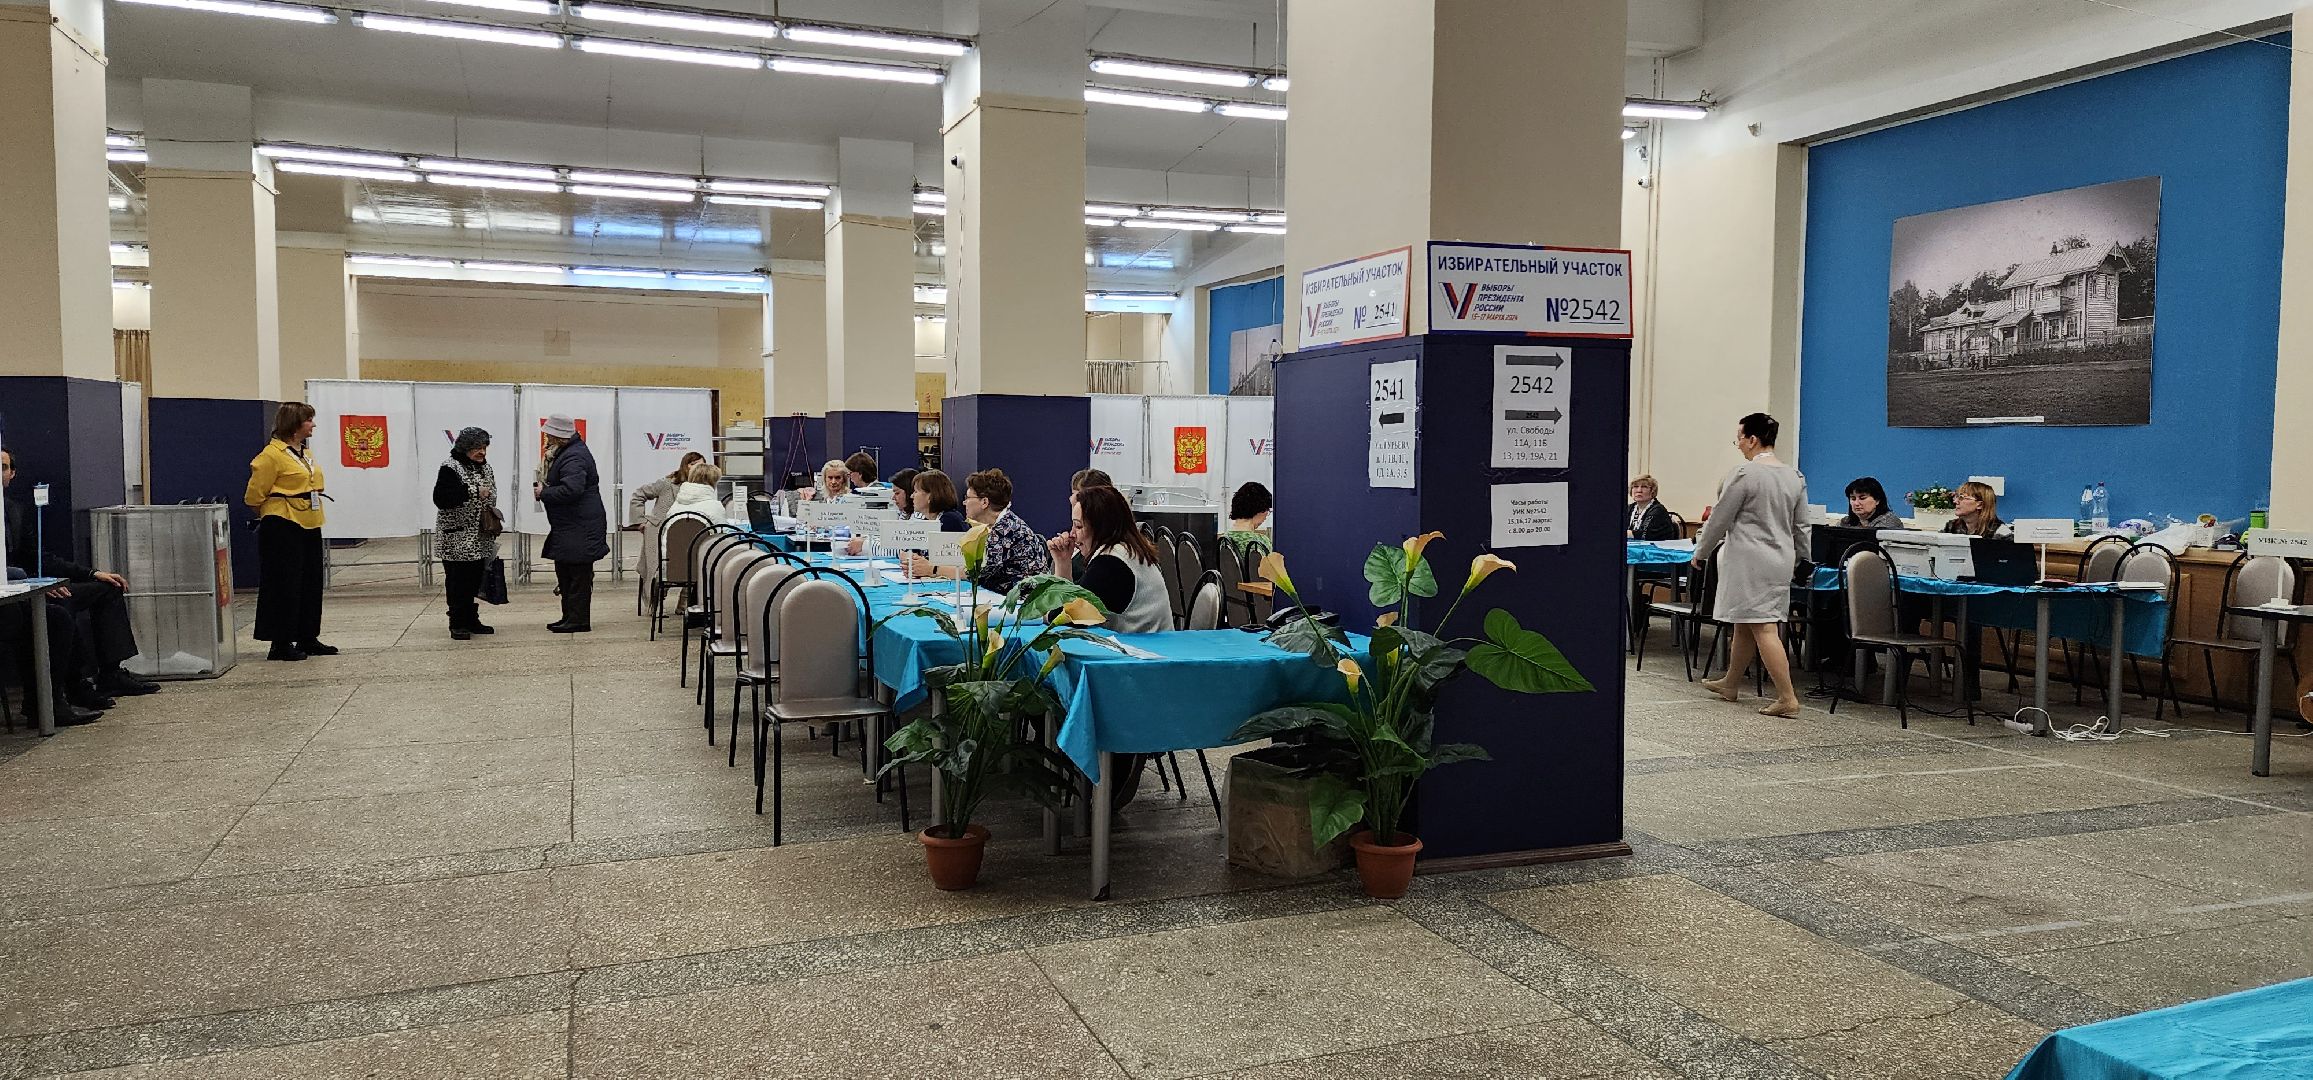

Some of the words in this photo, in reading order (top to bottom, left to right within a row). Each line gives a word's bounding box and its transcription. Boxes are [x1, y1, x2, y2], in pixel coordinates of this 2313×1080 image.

[1438, 256, 1558, 274] ИЗБИРАТЕЛЬНЫЙ
[1562, 261, 1623, 277] УЧАСТОК
[1305, 267, 1365, 295] ИЗБИРАТЕЛЬНЫЙ
[1365, 260, 1404, 282] УЧАСТОК
[1481, 283, 1515, 291] ВЫБОРЫ
[1477, 293, 1524, 302] ПРЕЗИДЕНТА
[1473, 303, 1504, 312] РОССИИ
[1510, 375, 1553, 393] 2542
[1374, 378, 1404, 401] 2541
[1520, 426, 1555, 435] Свободы
[1548, 452, 1558, 461] 21
